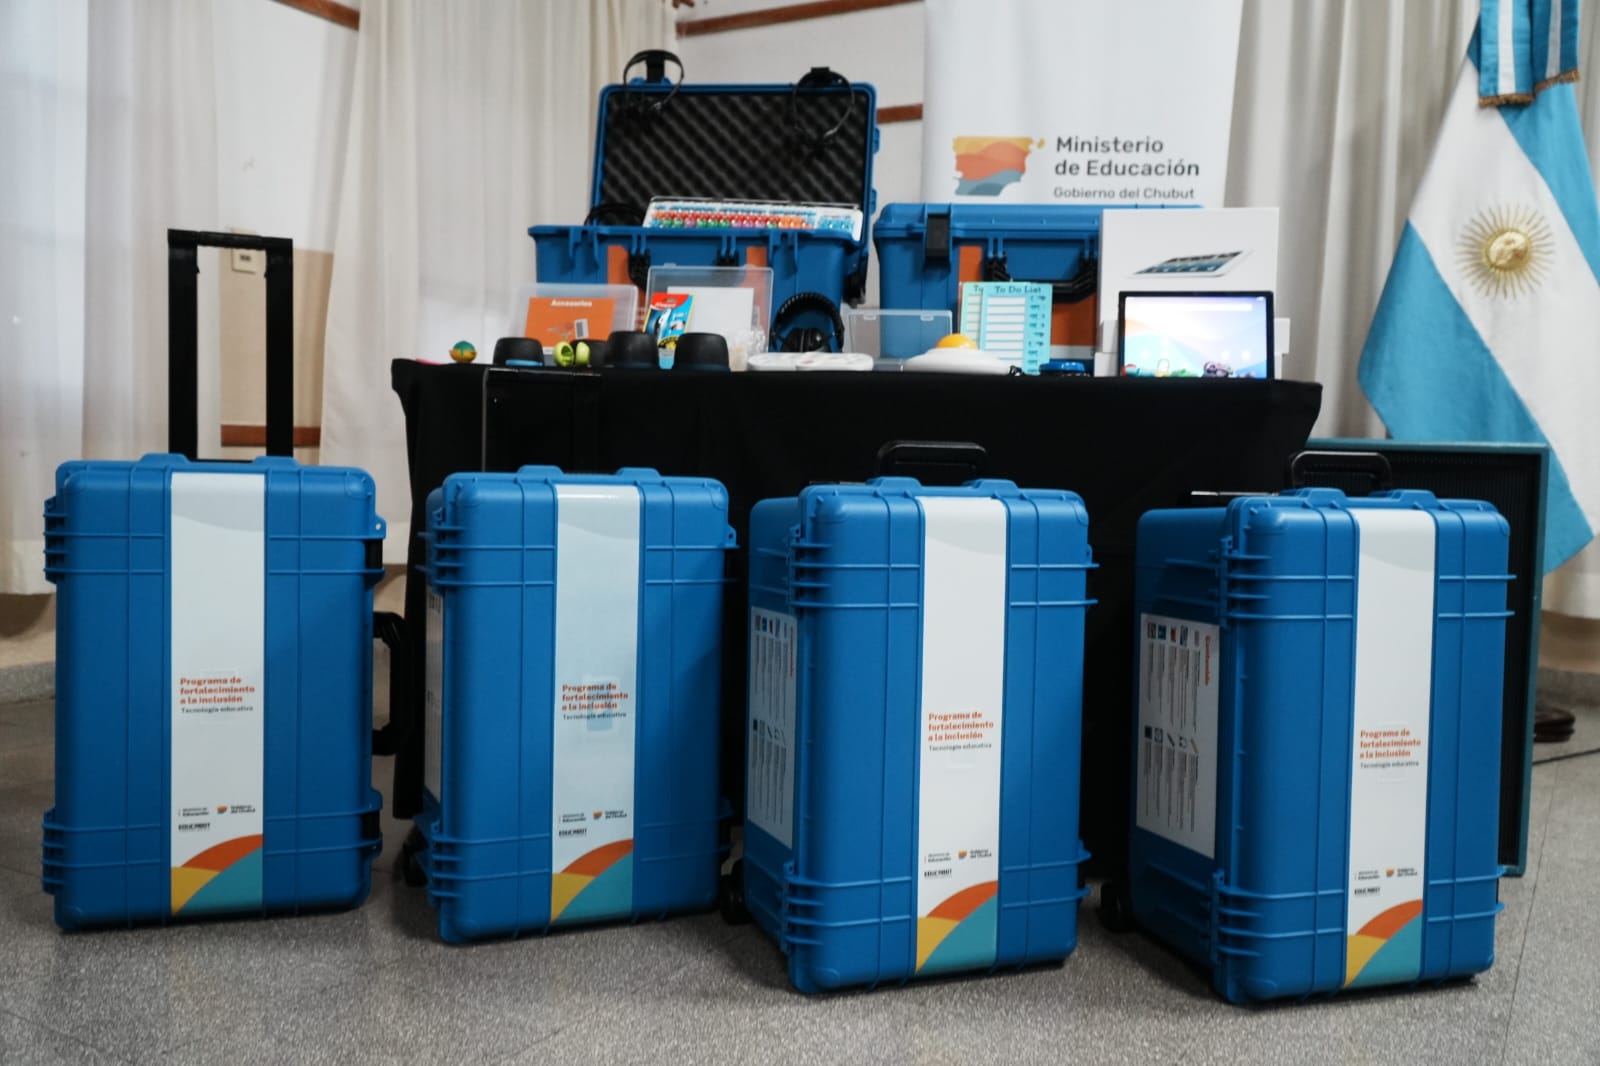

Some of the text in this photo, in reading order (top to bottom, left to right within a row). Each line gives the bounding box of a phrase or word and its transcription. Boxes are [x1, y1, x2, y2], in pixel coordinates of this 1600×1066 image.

[1056, 136, 1164, 153] Ministerio
[1055, 158, 1200, 176] de Educación
[1053, 187, 1195, 199] Gobierno del Chubut
[180, 676, 241, 686] Programa de
[180, 686, 255, 695] fortalecimiento
[562, 682, 617, 692] Programa de
[187, 696, 197, 704] la
[200, 695, 243, 703] inclusión
[562, 692, 629, 701] fortalecimiento
[928, 711, 983, 721] Programa de
[928, 722, 994, 731] fortalecimiento
[935, 733, 943, 741] la
[945, 731, 983, 740] inclusión
[1360, 728, 1410, 738] Programa de
[1360, 739, 1421, 748] fortalecimiento
[1366, 750, 1374, 758] la
[1375, 749, 1411, 758] inclusión
